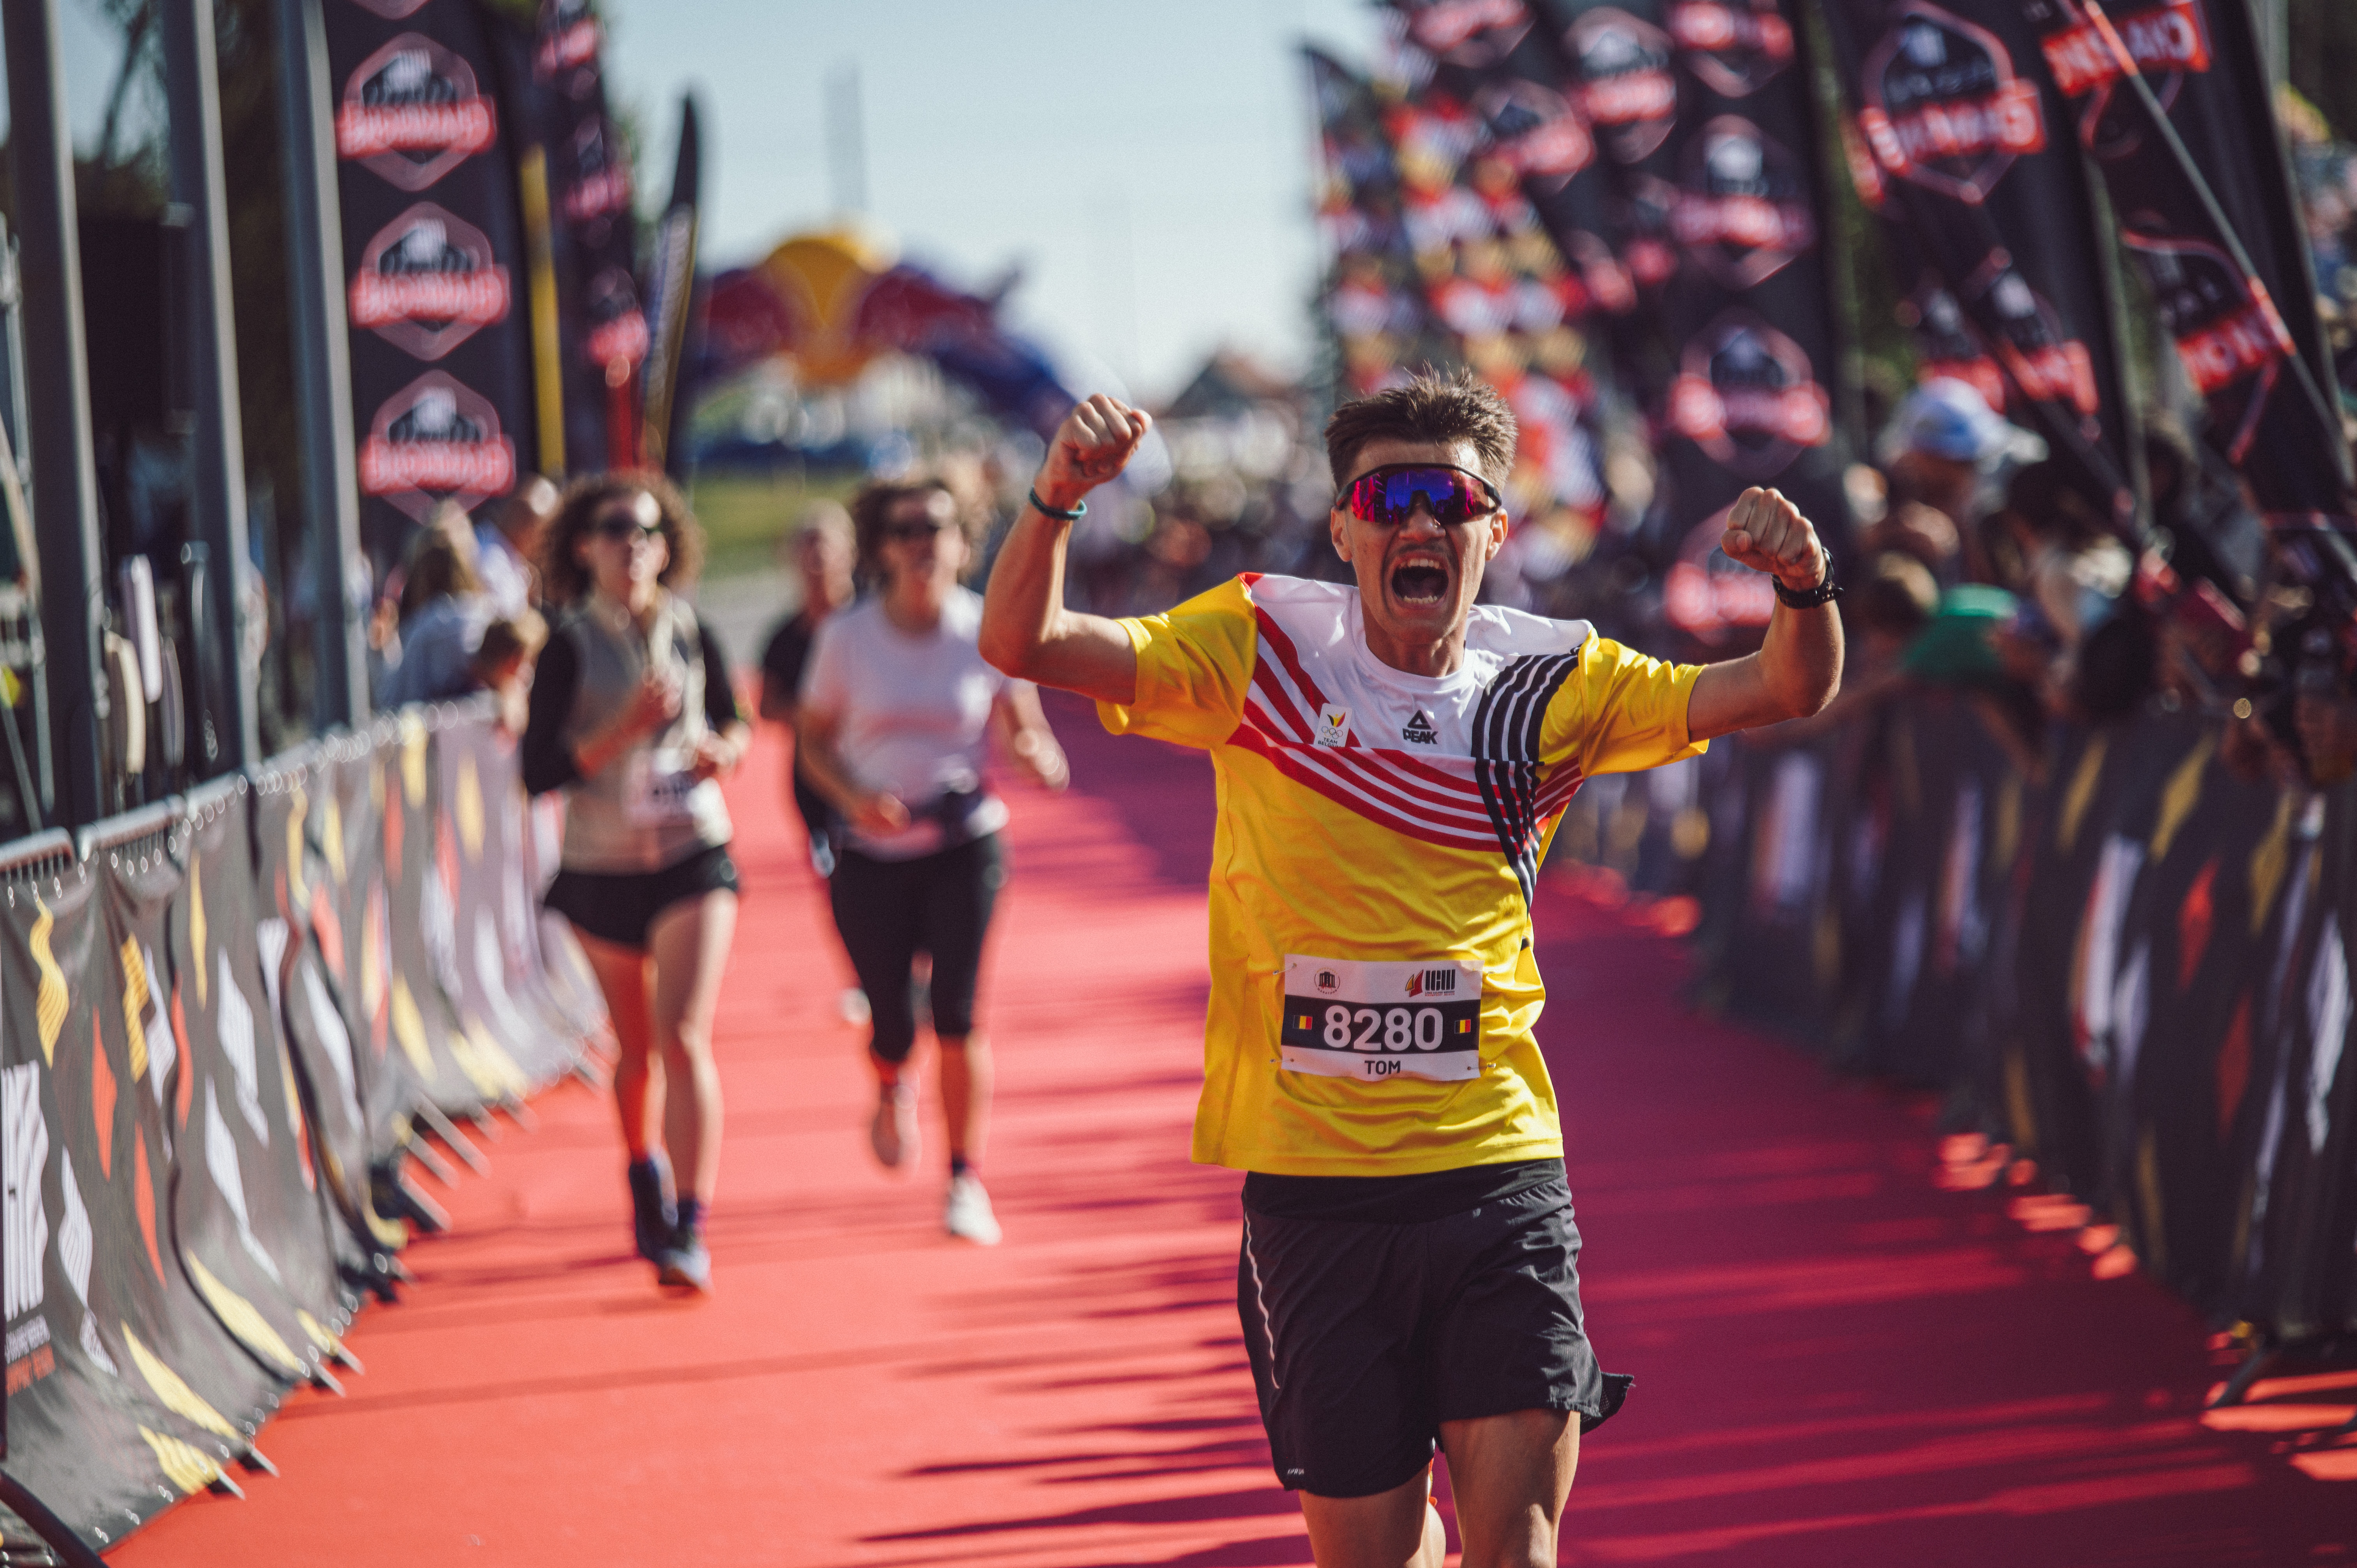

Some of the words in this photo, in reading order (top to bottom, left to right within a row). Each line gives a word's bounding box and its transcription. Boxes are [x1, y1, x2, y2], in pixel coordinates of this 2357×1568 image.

[1402, 727, 1438, 745] PEAK
[1323, 1005, 1444, 1051] 8280
[1364, 1060, 1401, 1075] TOM
